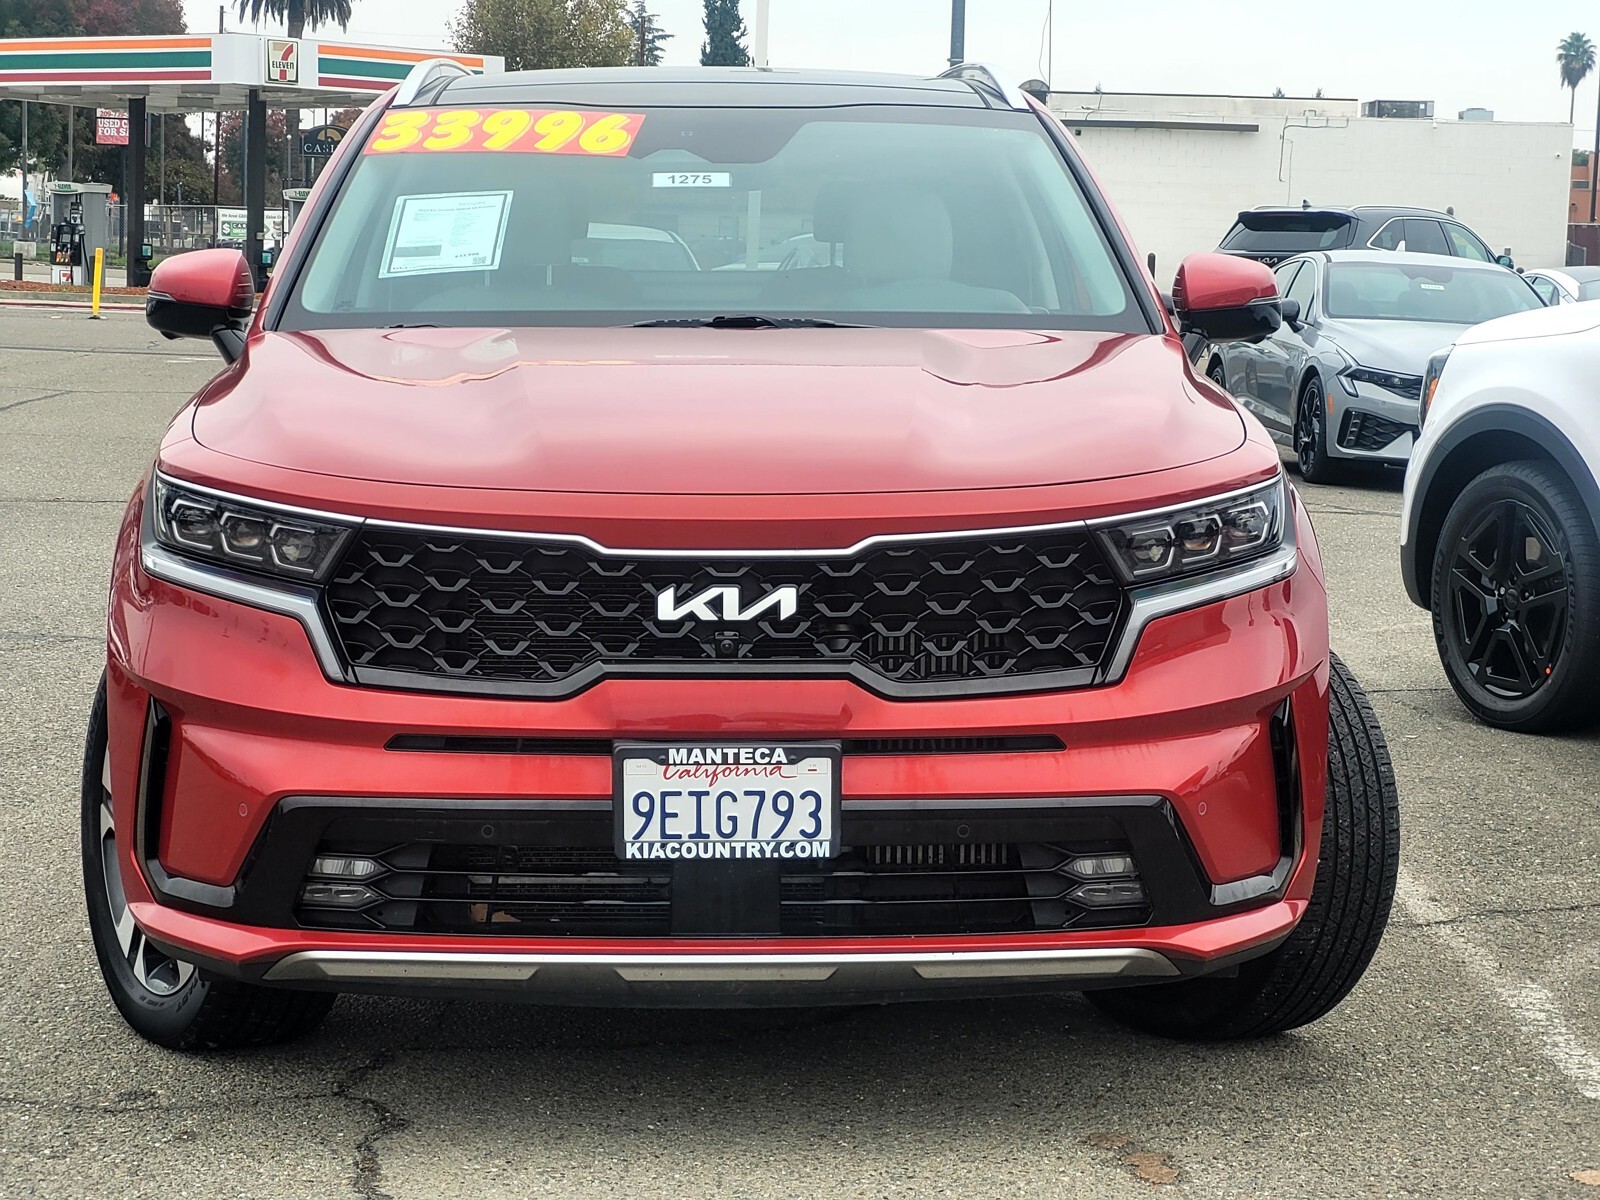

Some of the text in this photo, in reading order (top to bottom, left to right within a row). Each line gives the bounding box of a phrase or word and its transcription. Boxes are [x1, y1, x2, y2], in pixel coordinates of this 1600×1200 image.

[98, 119, 120, 128] USED
[98, 128, 117, 136] FOR
[371, 110, 632, 153] 33996
[304, 143, 335, 153] CASI
[667, 174, 712, 184] 1275
[657, 586, 797, 621] KIA
[668, 748, 788, 765] MANTECA
[662, 764, 798, 788] California
[632, 790, 822, 840] 9EIG793
[625, 841, 831, 859] KIACOUNTRY.COM
